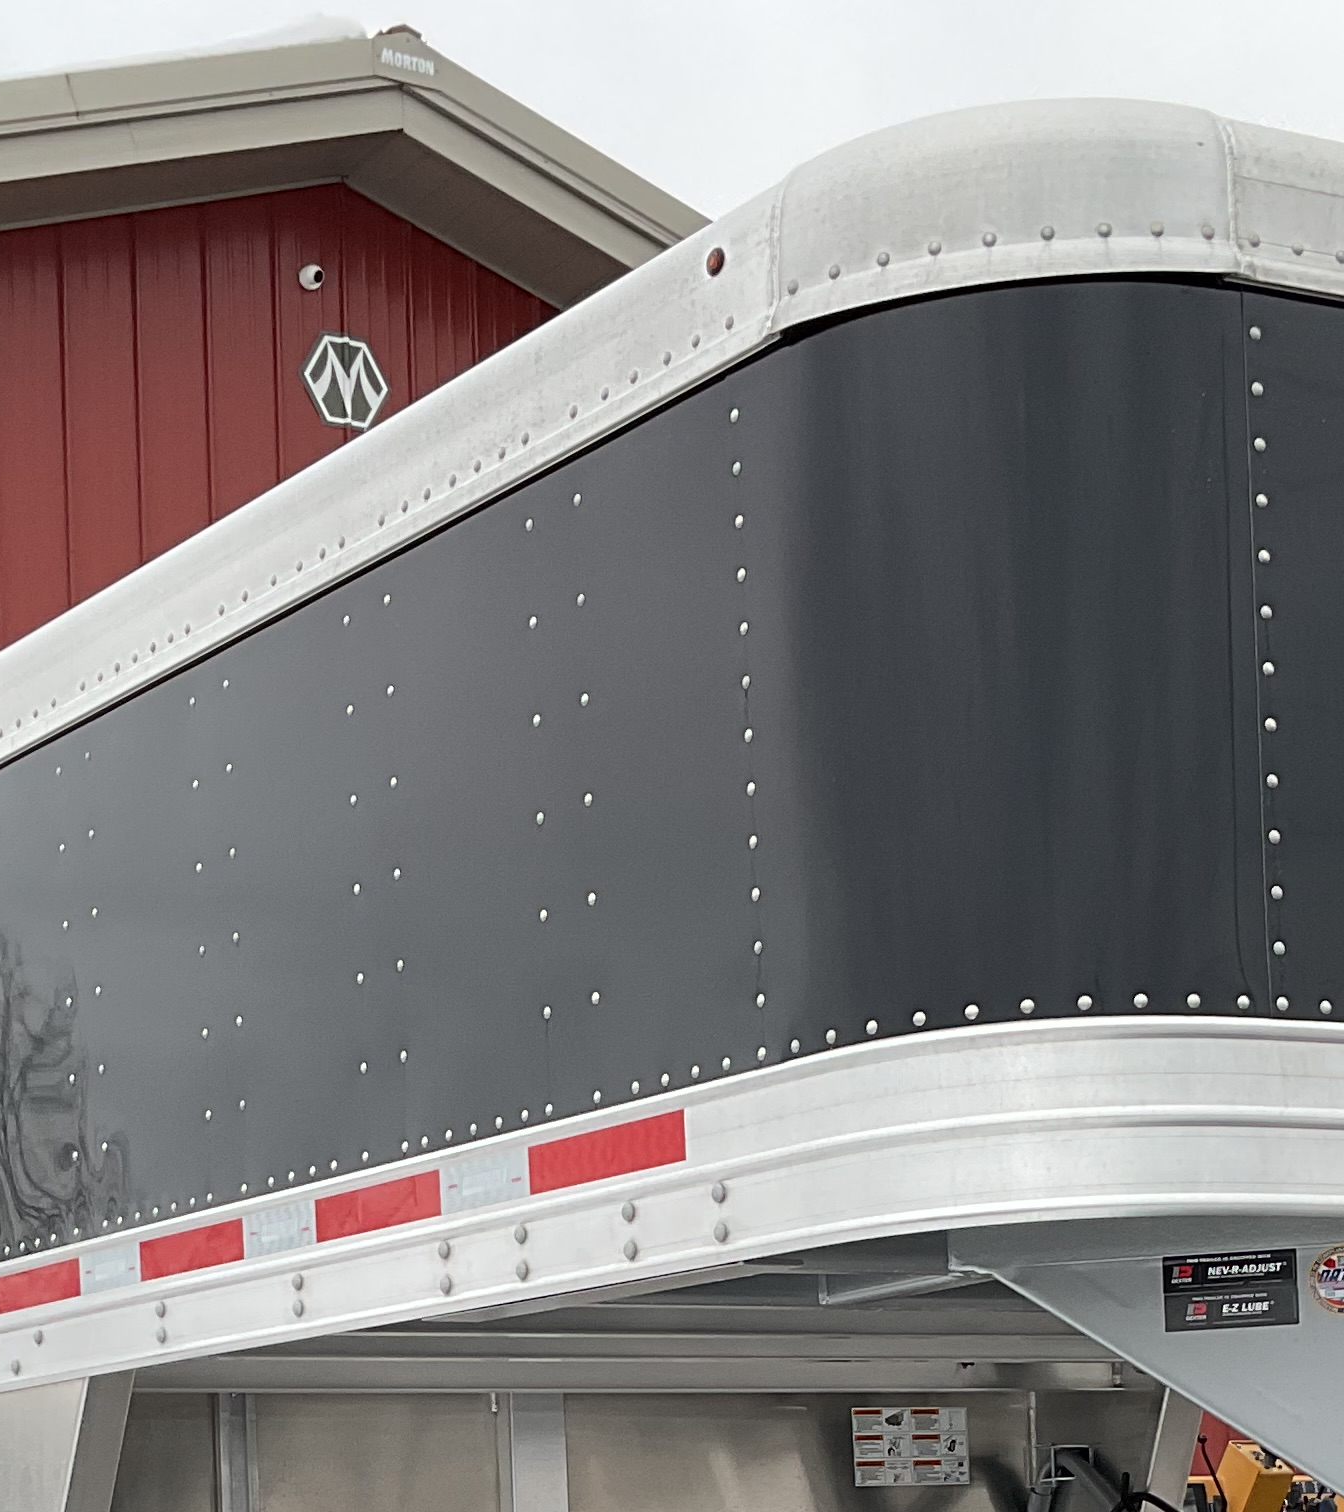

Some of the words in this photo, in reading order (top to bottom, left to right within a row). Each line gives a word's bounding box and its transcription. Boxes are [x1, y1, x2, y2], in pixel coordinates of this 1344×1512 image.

[381, 47, 434, 76] MORTON
[1222, 1303, 1240, 1313] E-Z
[1241, 1302, 1270, 1312] LUBE
